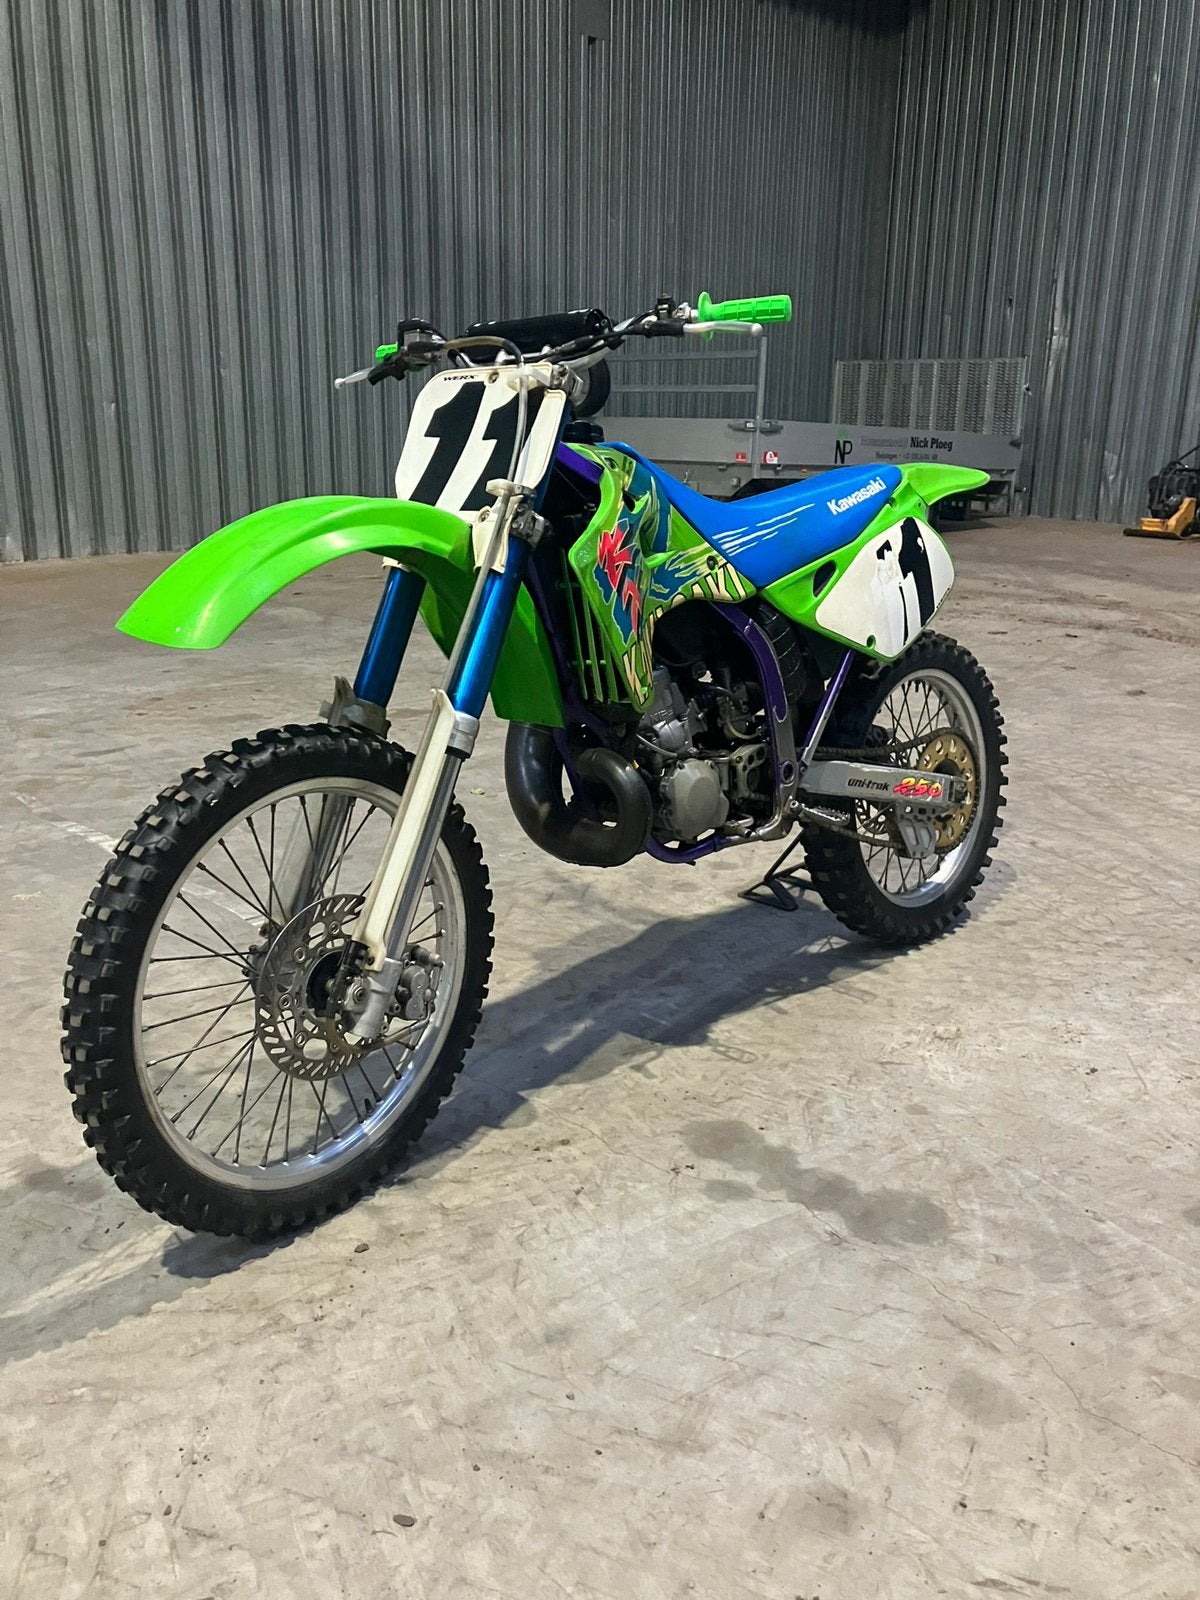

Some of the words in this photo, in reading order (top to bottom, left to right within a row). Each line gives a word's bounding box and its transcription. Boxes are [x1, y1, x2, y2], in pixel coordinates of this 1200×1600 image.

[409, 382, 547, 511] 11
[910, 436, 928, 449] Nick
[930, 437, 953, 452] Ploeg
[826, 476, 887, 515] Kawasaki
[892, 777, 942, 799] 250
